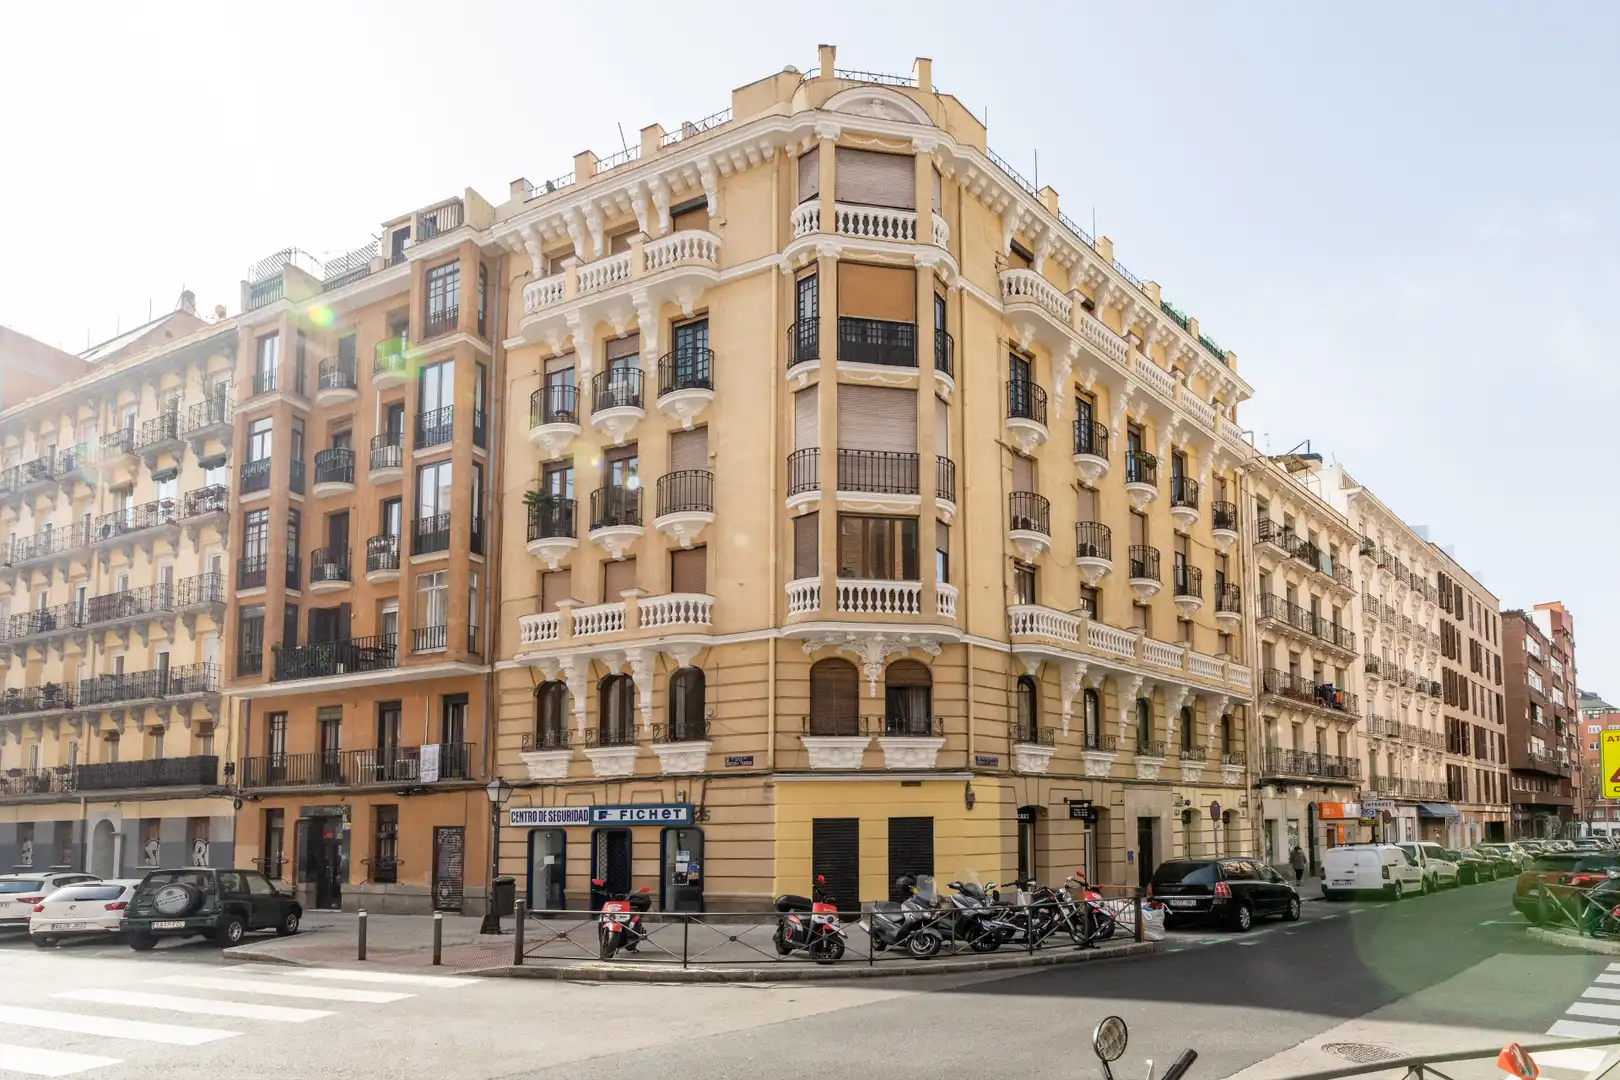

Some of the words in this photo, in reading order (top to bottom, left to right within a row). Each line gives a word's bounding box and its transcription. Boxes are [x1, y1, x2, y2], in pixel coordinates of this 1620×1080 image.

[511, 811, 537, 823] CENTRO
[537, 810, 548, 822] DE
[548, 809, 589, 822] SEGURIDAD
